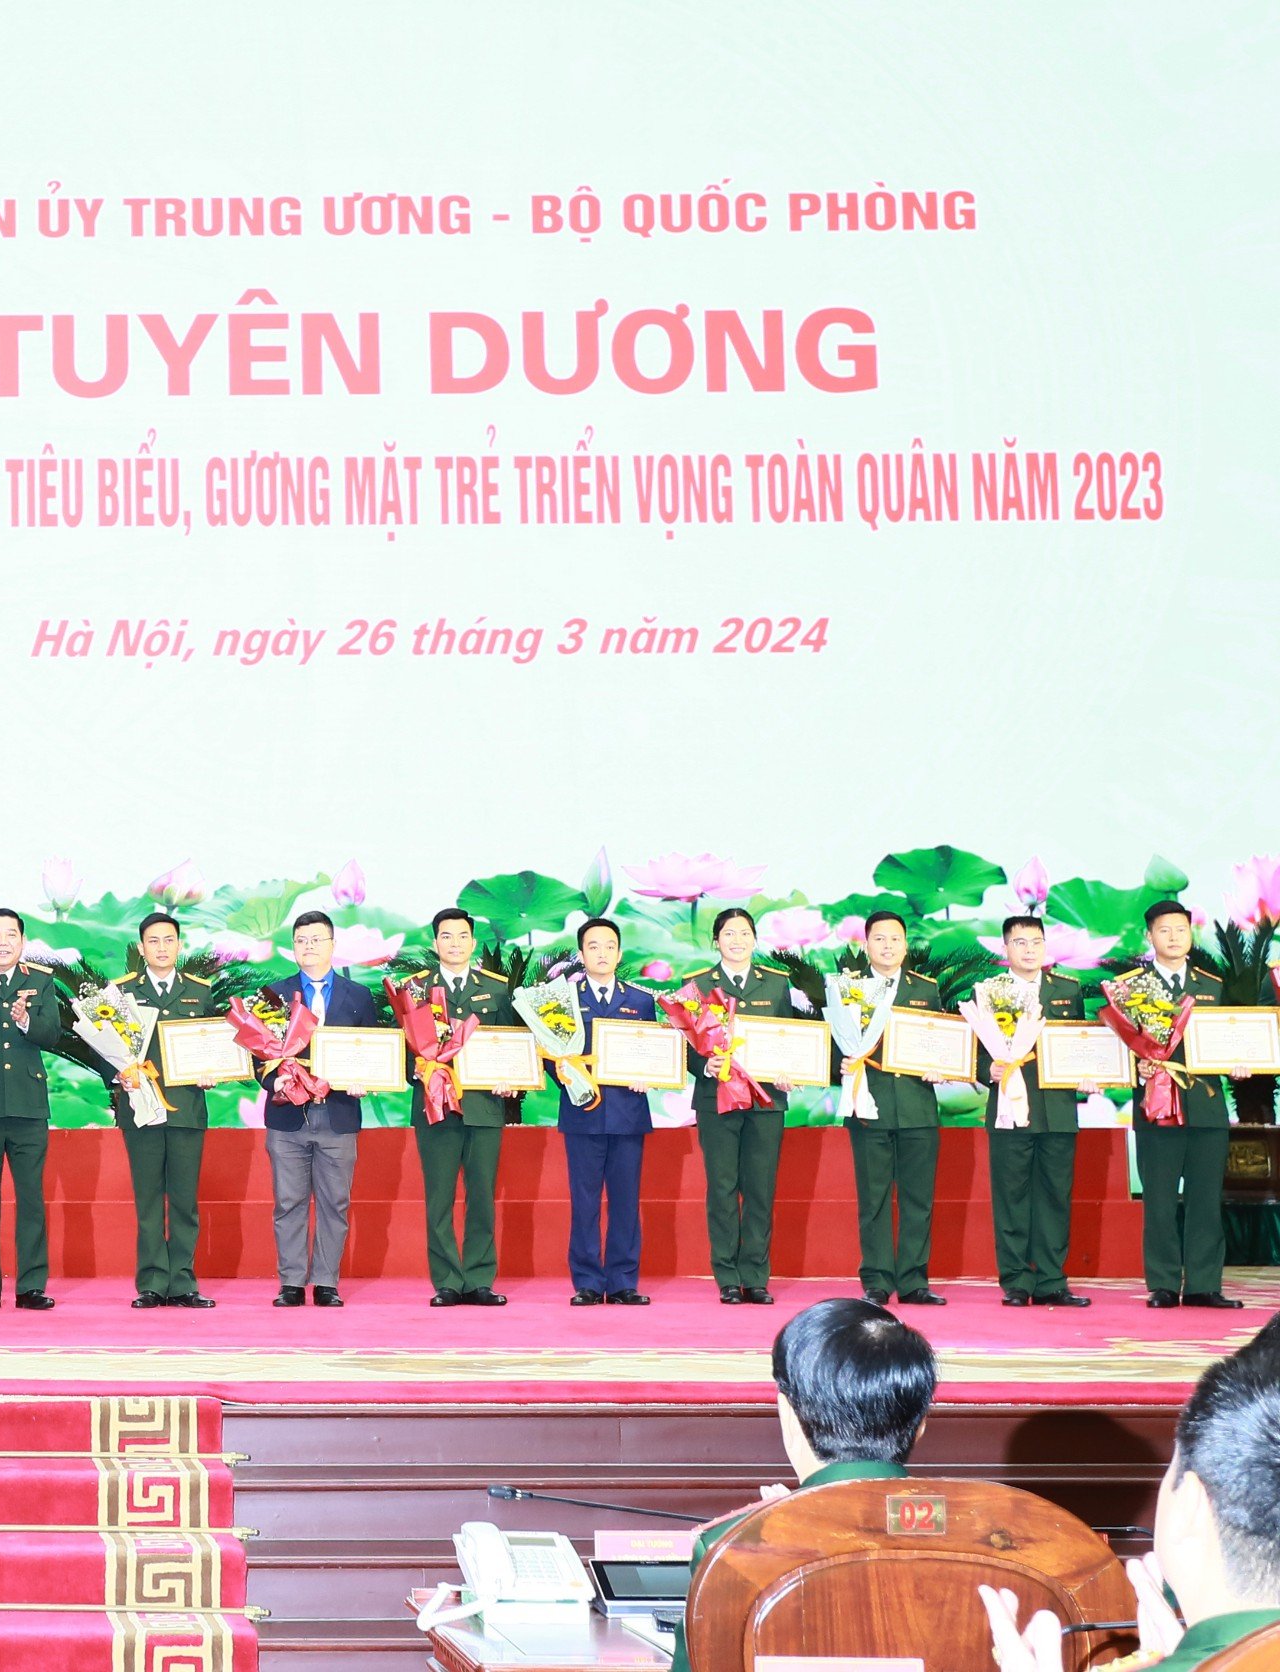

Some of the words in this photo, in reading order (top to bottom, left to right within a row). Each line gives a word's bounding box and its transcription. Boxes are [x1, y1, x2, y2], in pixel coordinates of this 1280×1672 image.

[37, 180, 105, 239] ỦY
[122, 196, 303, 238] TRUNG
[323, 191, 471, 236] ƯƠNG
[492, 213, 510, 222] -
[531, 185, 602, 244] BỘ
[622, 177, 768, 239] QUỐC
[788, 181, 977, 232] PHÒNG
[428, 298, 879, 396] DƯƠNG
[5, 442, 84, 528] TIÊU
[97, 427, 192, 536] BIỂU,
[205, 449, 331, 528] GƯƠNG
[344, 441, 423, 542] MẶT
[434, 424, 502, 525] TRẺ
[513, 424, 621, 525] TRIỂN
[632, 453, 734, 541] VỌNG
[744, 438, 844, 524] TOÀN
[856, 437, 960, 532] QUÂN
[971, 438, 1060, 522] NĂM
[1072, 450, 1165, 522] 2023
[31, 619, 94, 657] Hà
[105, 619, 194, 669] Nội,
[213, 617, 326, 666] ngày
[337, 618, 398, 656] 26
[412, 616, 544, 665] tháng
[556, 617, 589, 655] 3
[599, 616, 700, 655] năm
[712, 616, 830, 654] 2024
[899, 1500, 936, 1530] 02
